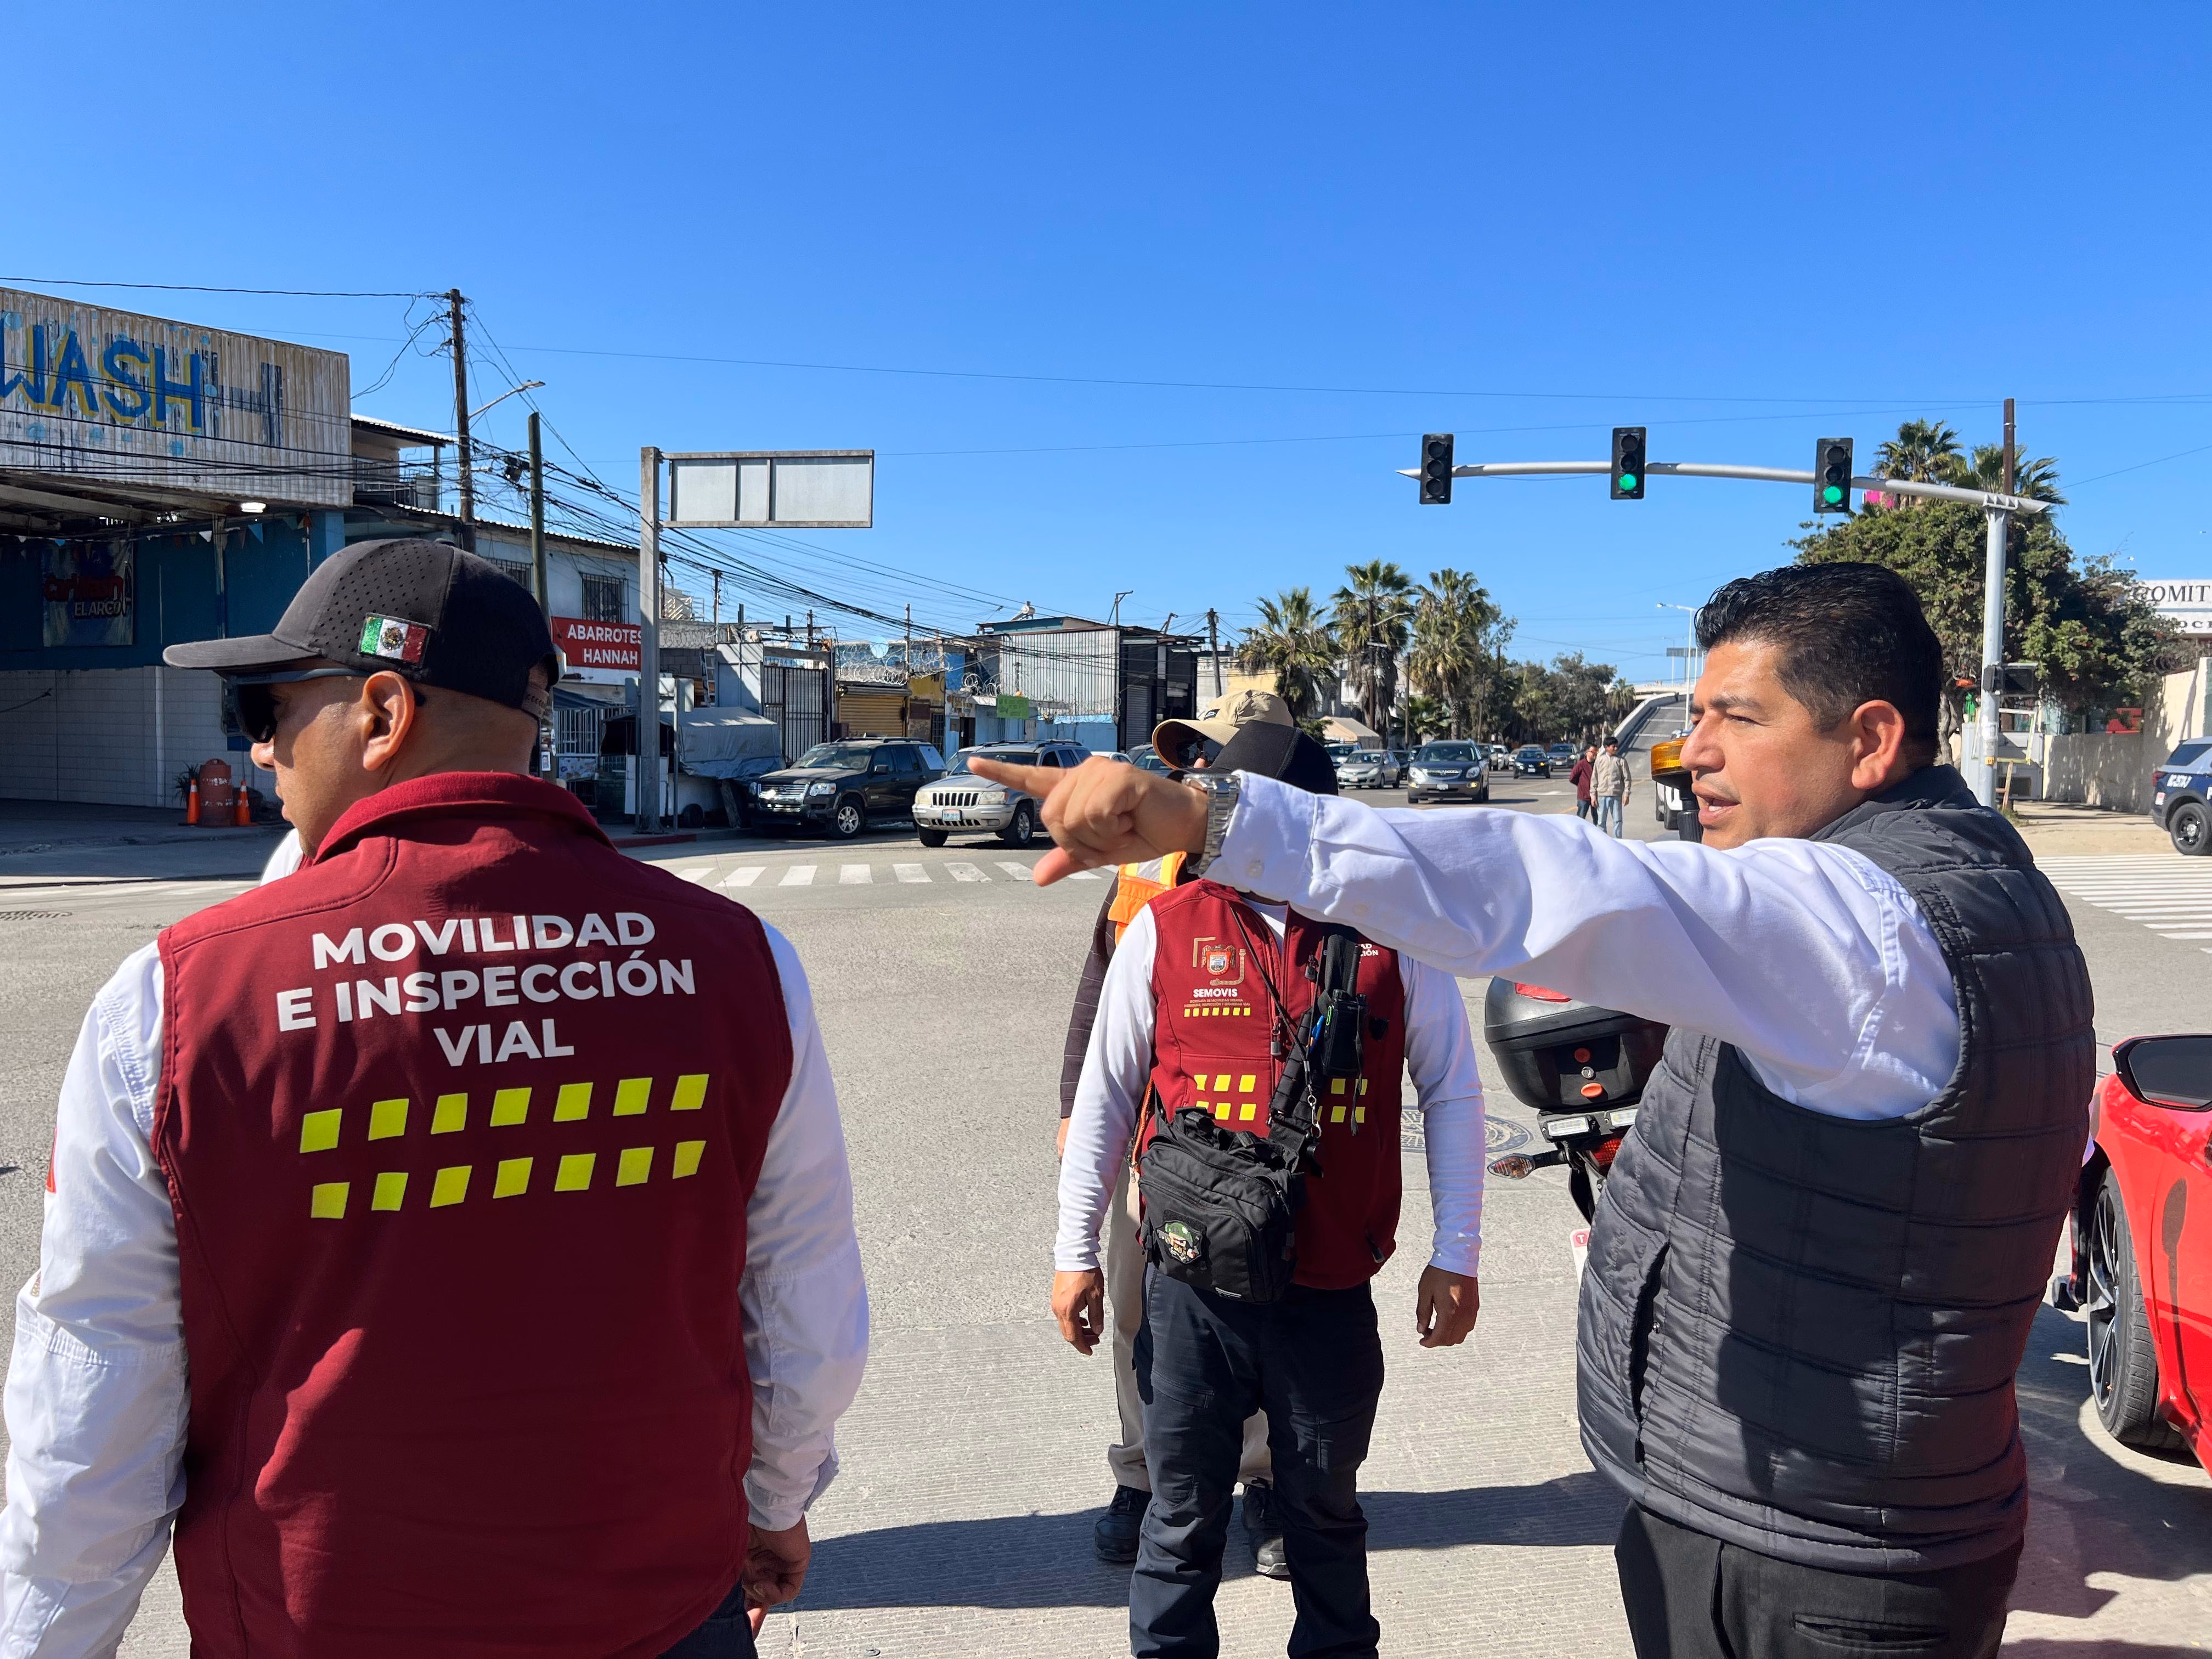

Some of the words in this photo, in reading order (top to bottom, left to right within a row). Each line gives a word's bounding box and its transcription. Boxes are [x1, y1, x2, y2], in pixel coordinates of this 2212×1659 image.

[0, 316, 202, 431] WASH
[583, 648, 637, 665] HANNAH
[312, 912, 656, 970] MOVILIDAD
[276, 988, 317, 1032] E
[335, 951, 696, 1023] INSPECCIÓN
[1193, 988, 1238, 998] SEMOVIS
[433, 1018, 574, 1066] VIAL
